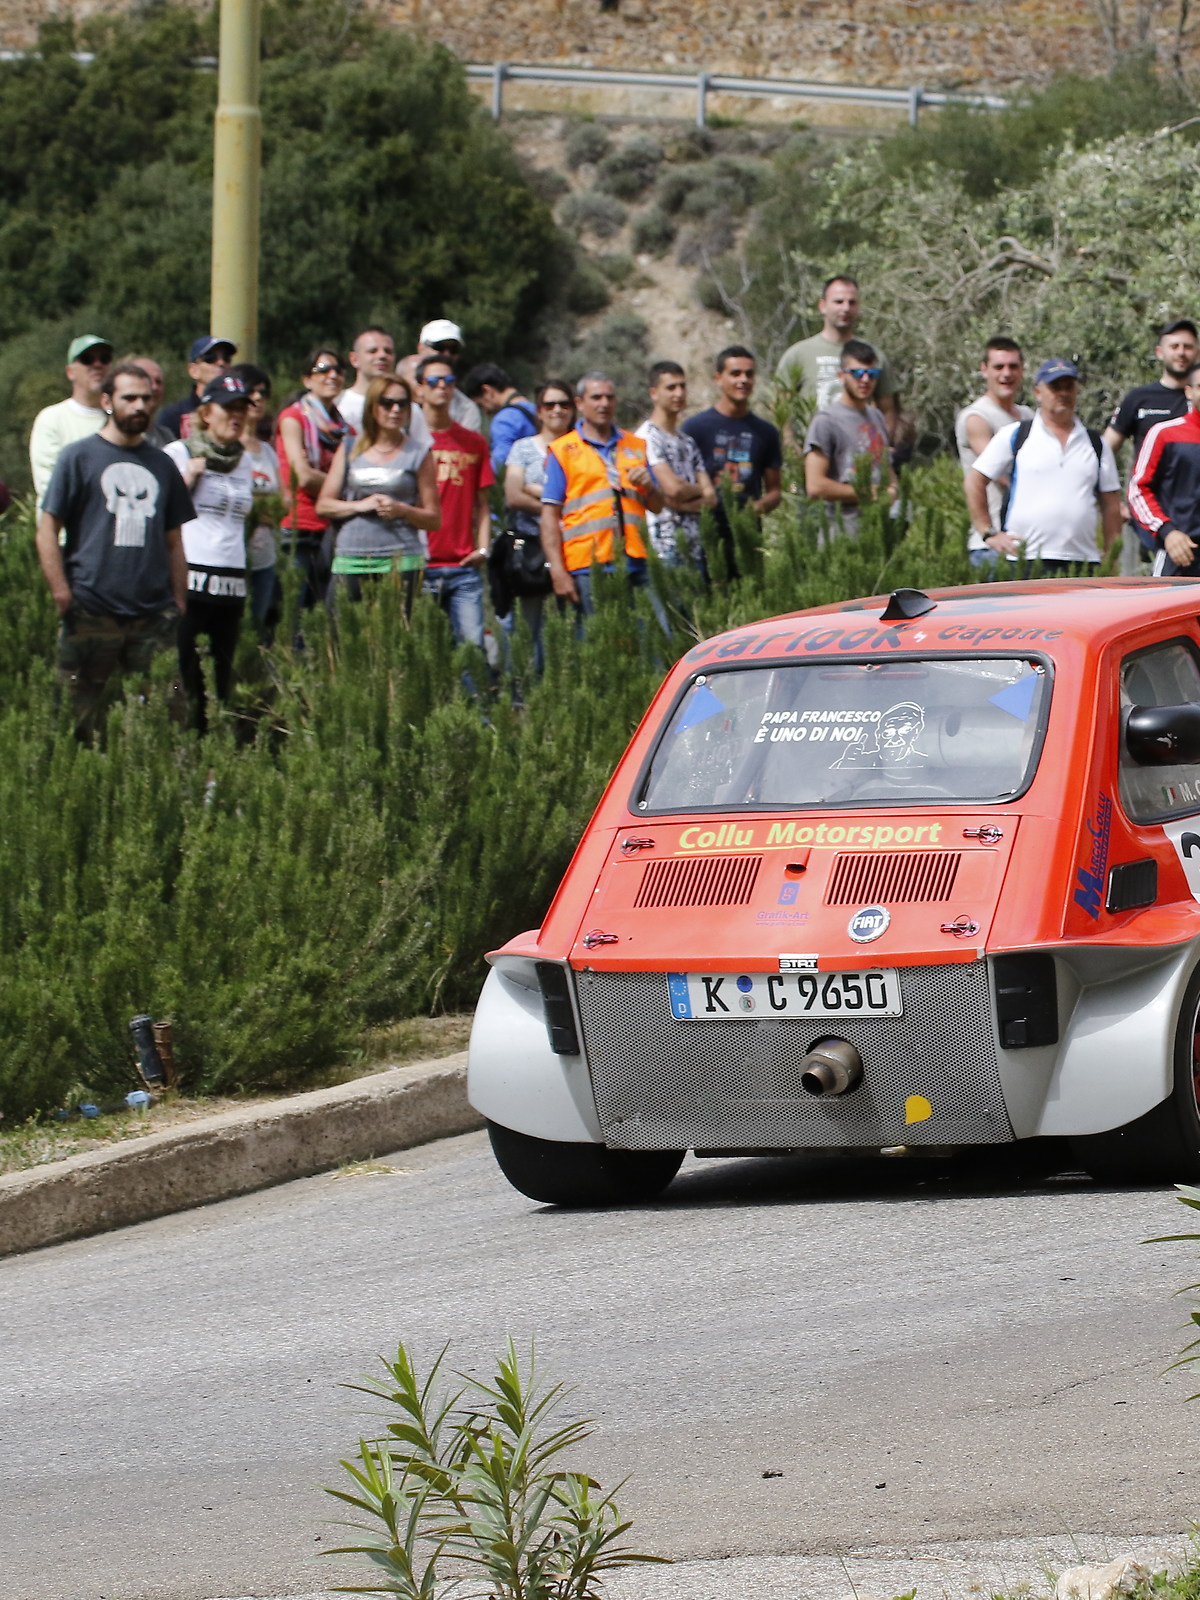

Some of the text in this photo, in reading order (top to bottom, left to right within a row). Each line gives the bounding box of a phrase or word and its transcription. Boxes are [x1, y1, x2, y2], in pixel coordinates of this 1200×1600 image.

[683, 622, 919, 663] Carlook
[937, 625, 1063, 646] Capone
[761, 711, 881, 725] PAPA FRANCESCO
[753, 725, 864, 743] È UNO DI NOI
[1179, 782, 1197, 802] M.
[678, 823, 942, 848] Collu Motorsport
[757, 911, 810, 920] Grafik-Art
[853, 915, 883, 930] FIAT
[701, 973, 888, 1012] K C 9650
[678, 1003, 687, 1014] D
